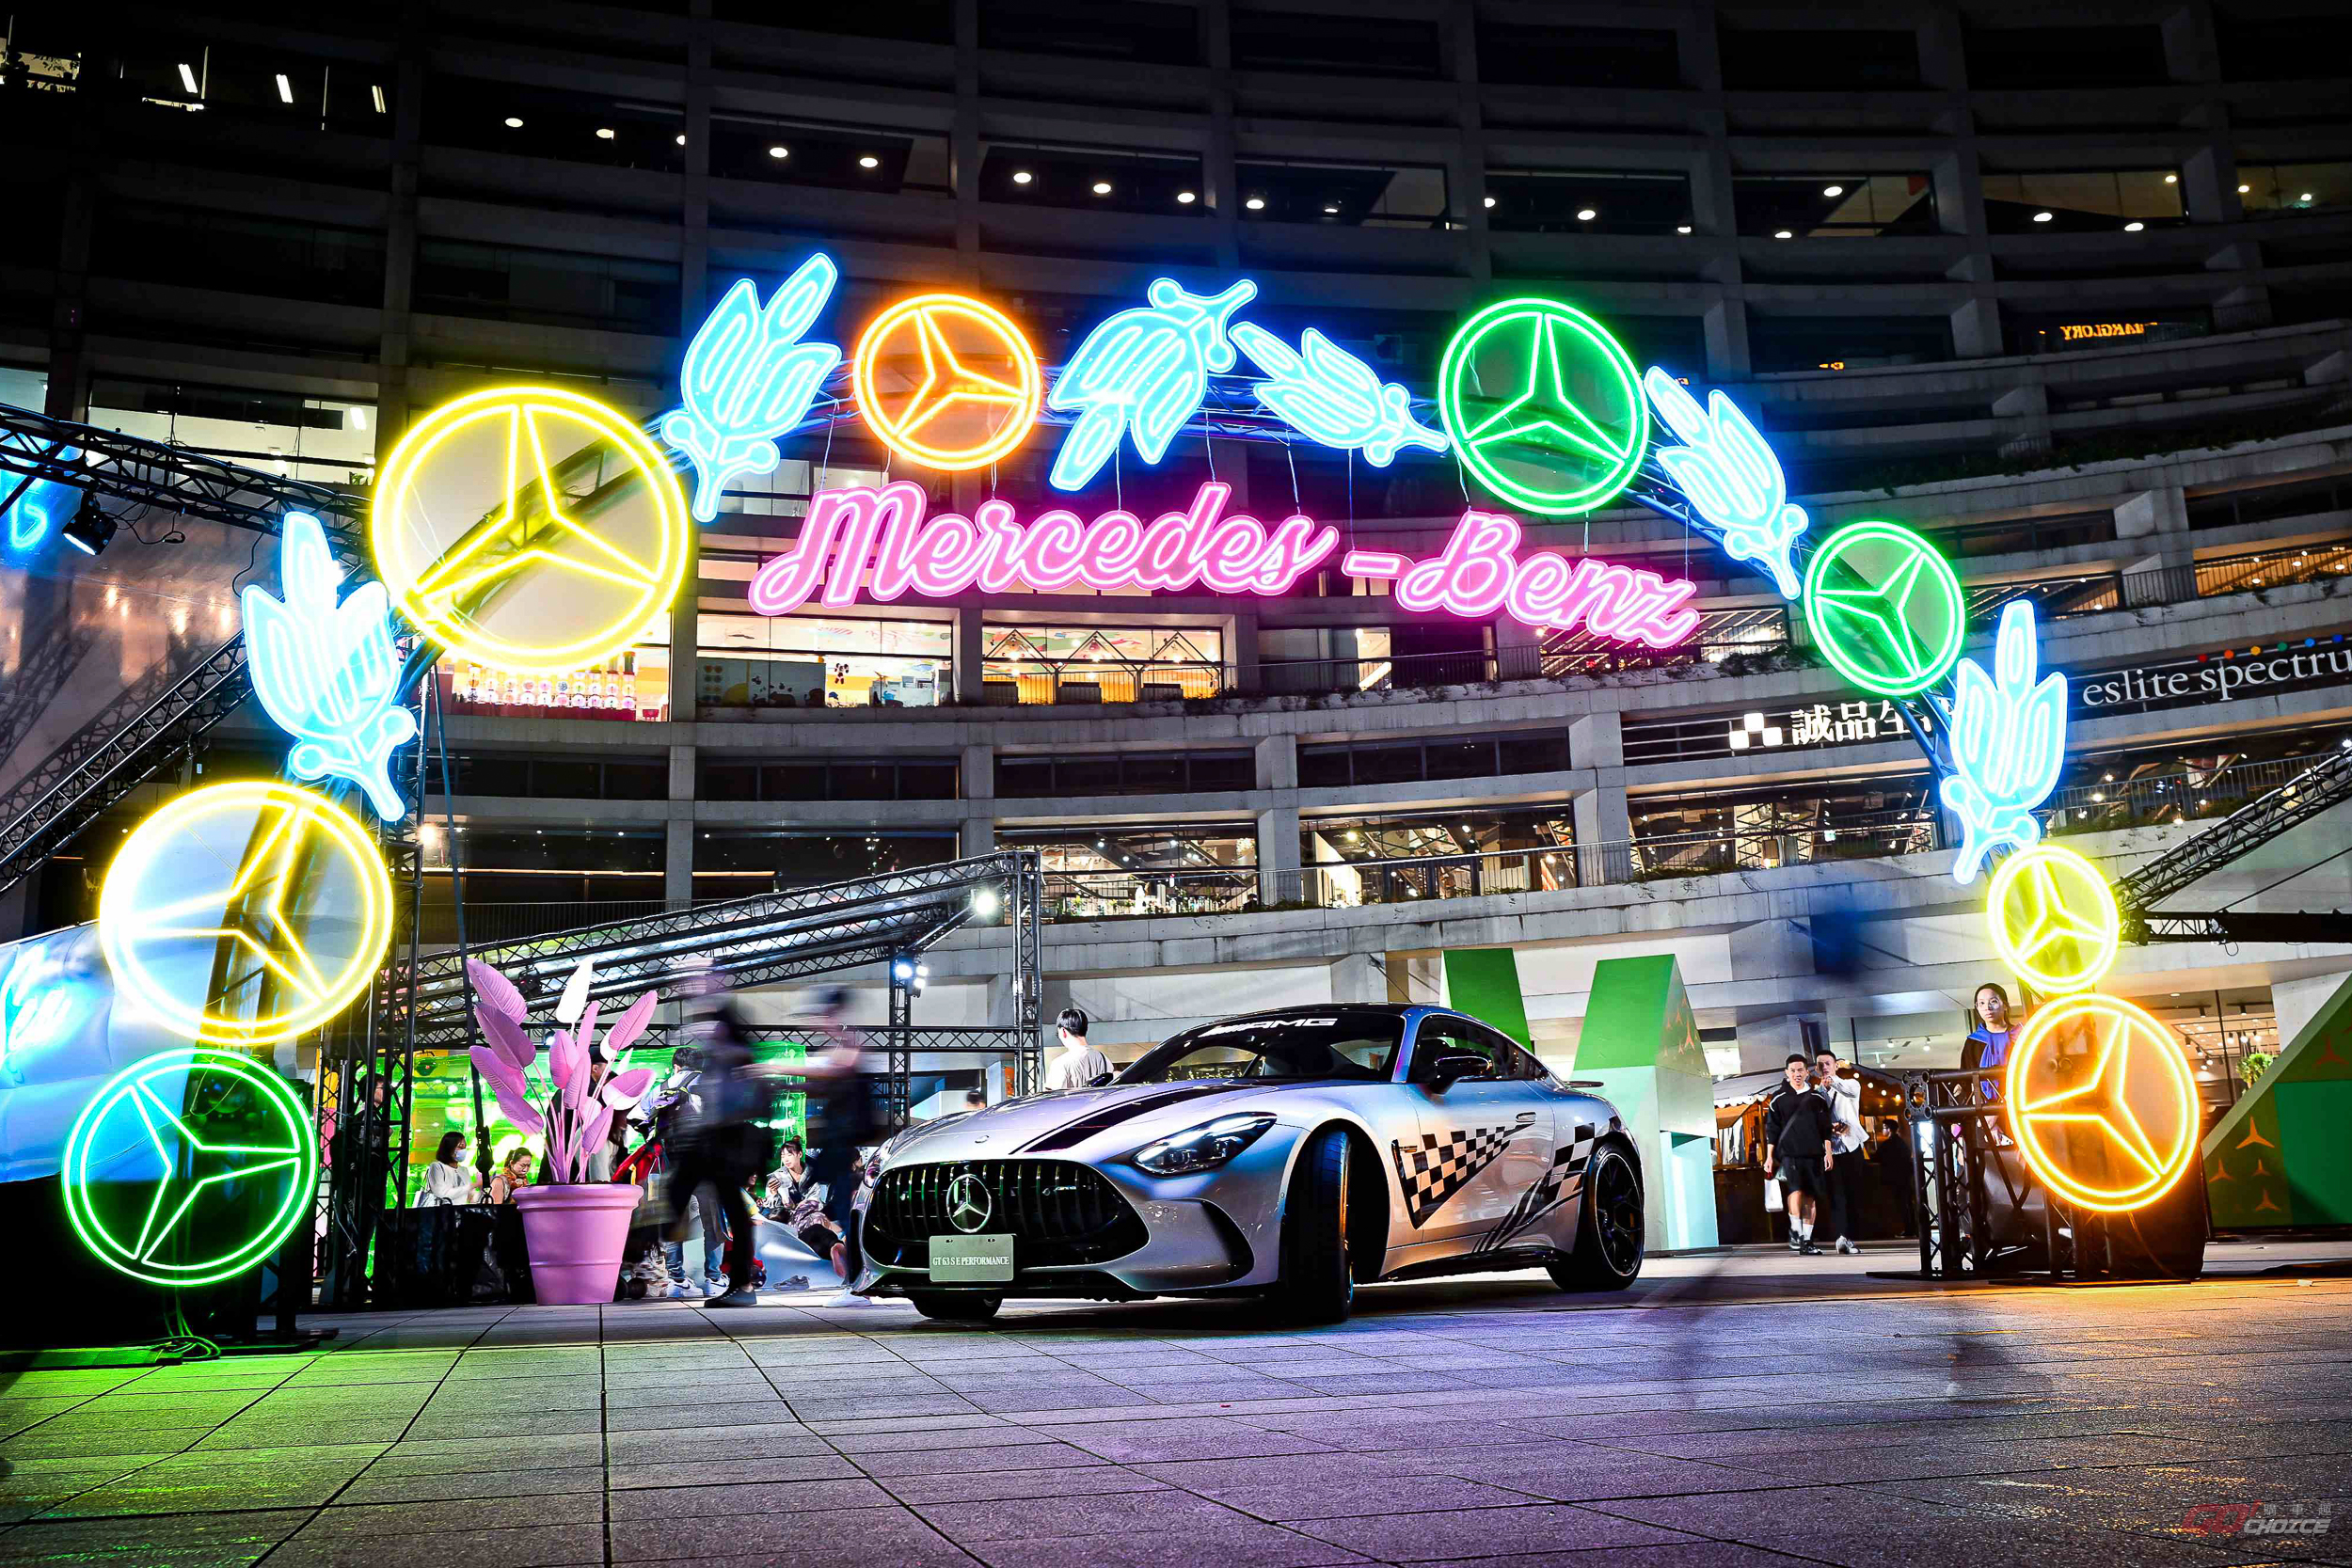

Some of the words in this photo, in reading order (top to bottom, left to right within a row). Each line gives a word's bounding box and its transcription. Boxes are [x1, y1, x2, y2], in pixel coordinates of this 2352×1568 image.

[2082, 668, 2190, 705] eslite
[1790, 699, 1957, 745] 誠品生
[932, 1257, 942, 1266] GT
[942, 1257, 950, 1266] 63
[950, 1257, 956, 1266] S
[956, 1257, 961, 1266] E
[961, 1256, 1009, 1266] PERFORMANCE
